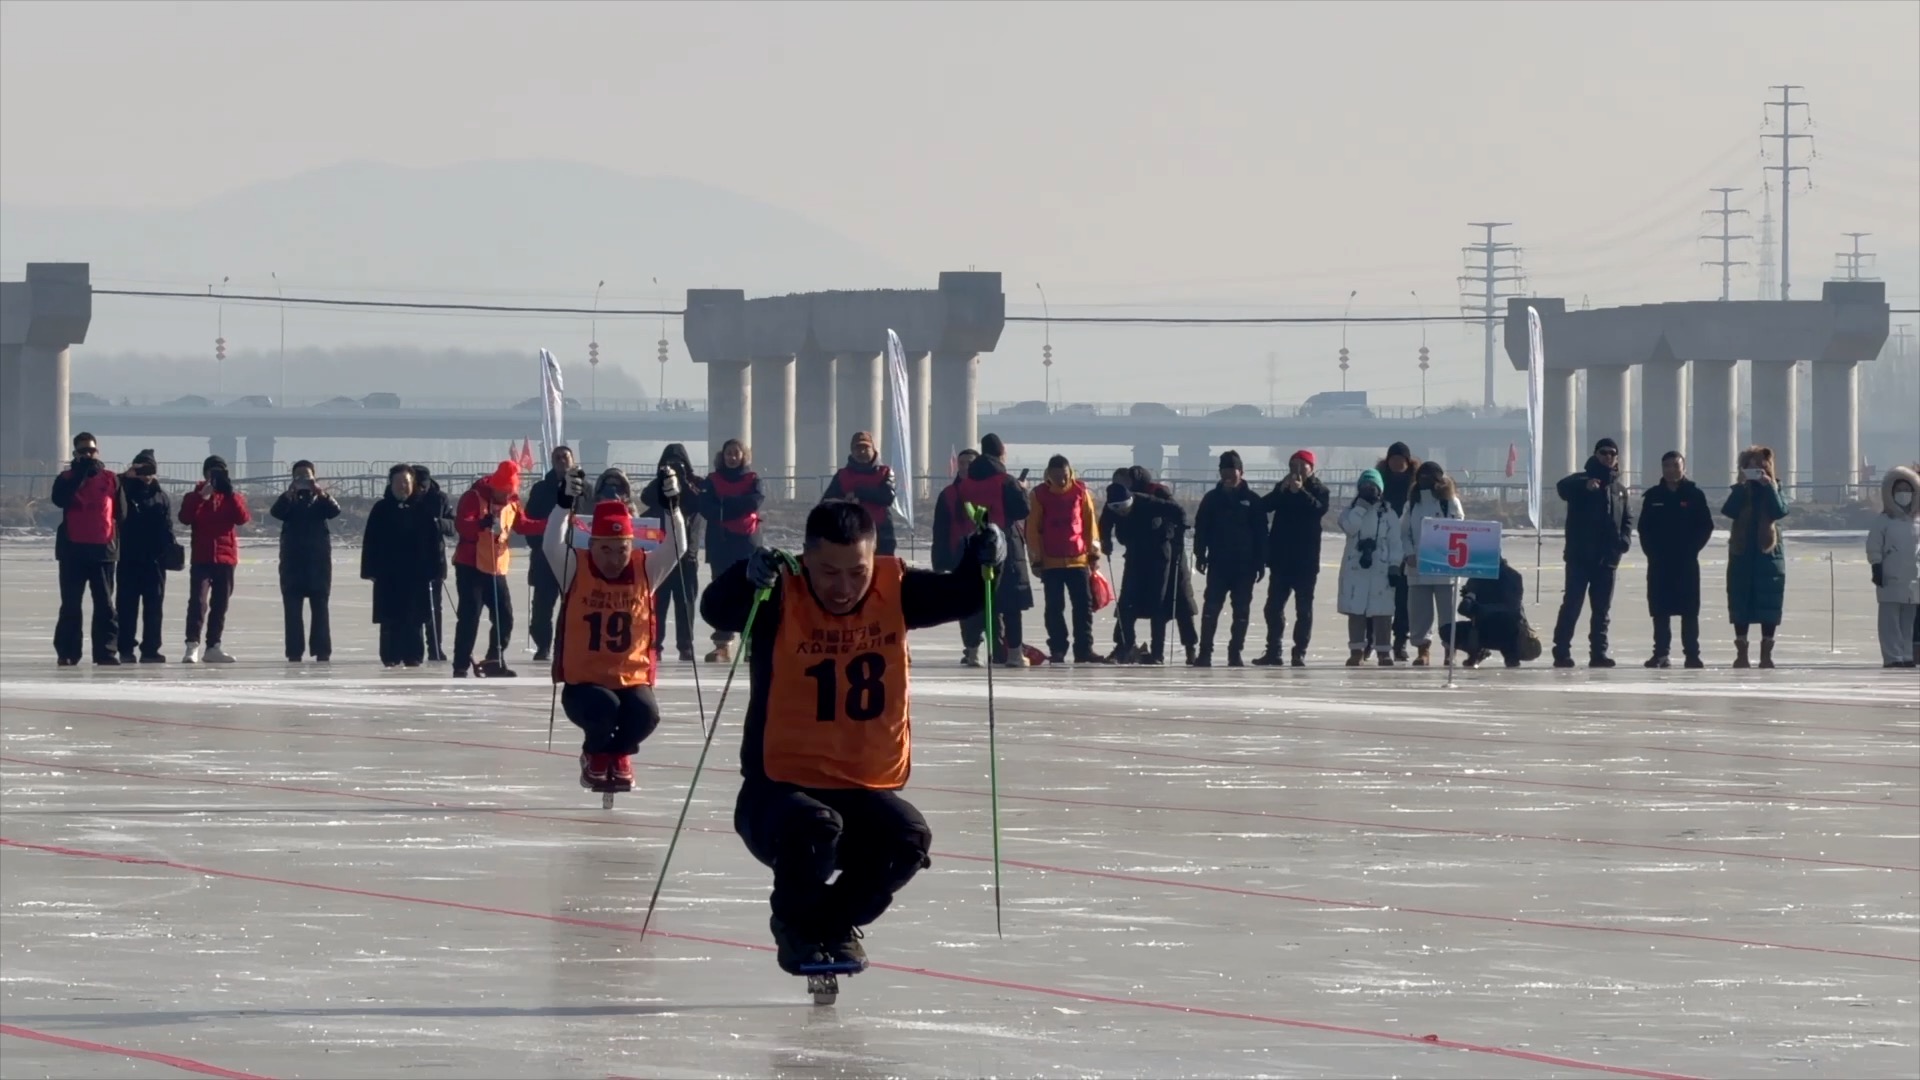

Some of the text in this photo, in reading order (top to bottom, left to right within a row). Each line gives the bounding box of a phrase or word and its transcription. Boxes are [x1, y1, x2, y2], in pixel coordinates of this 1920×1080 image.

[1447, 533, 1468, 568] 5
[583, 611, 632, 653] 19
[804, 652, 887, 722] 18
